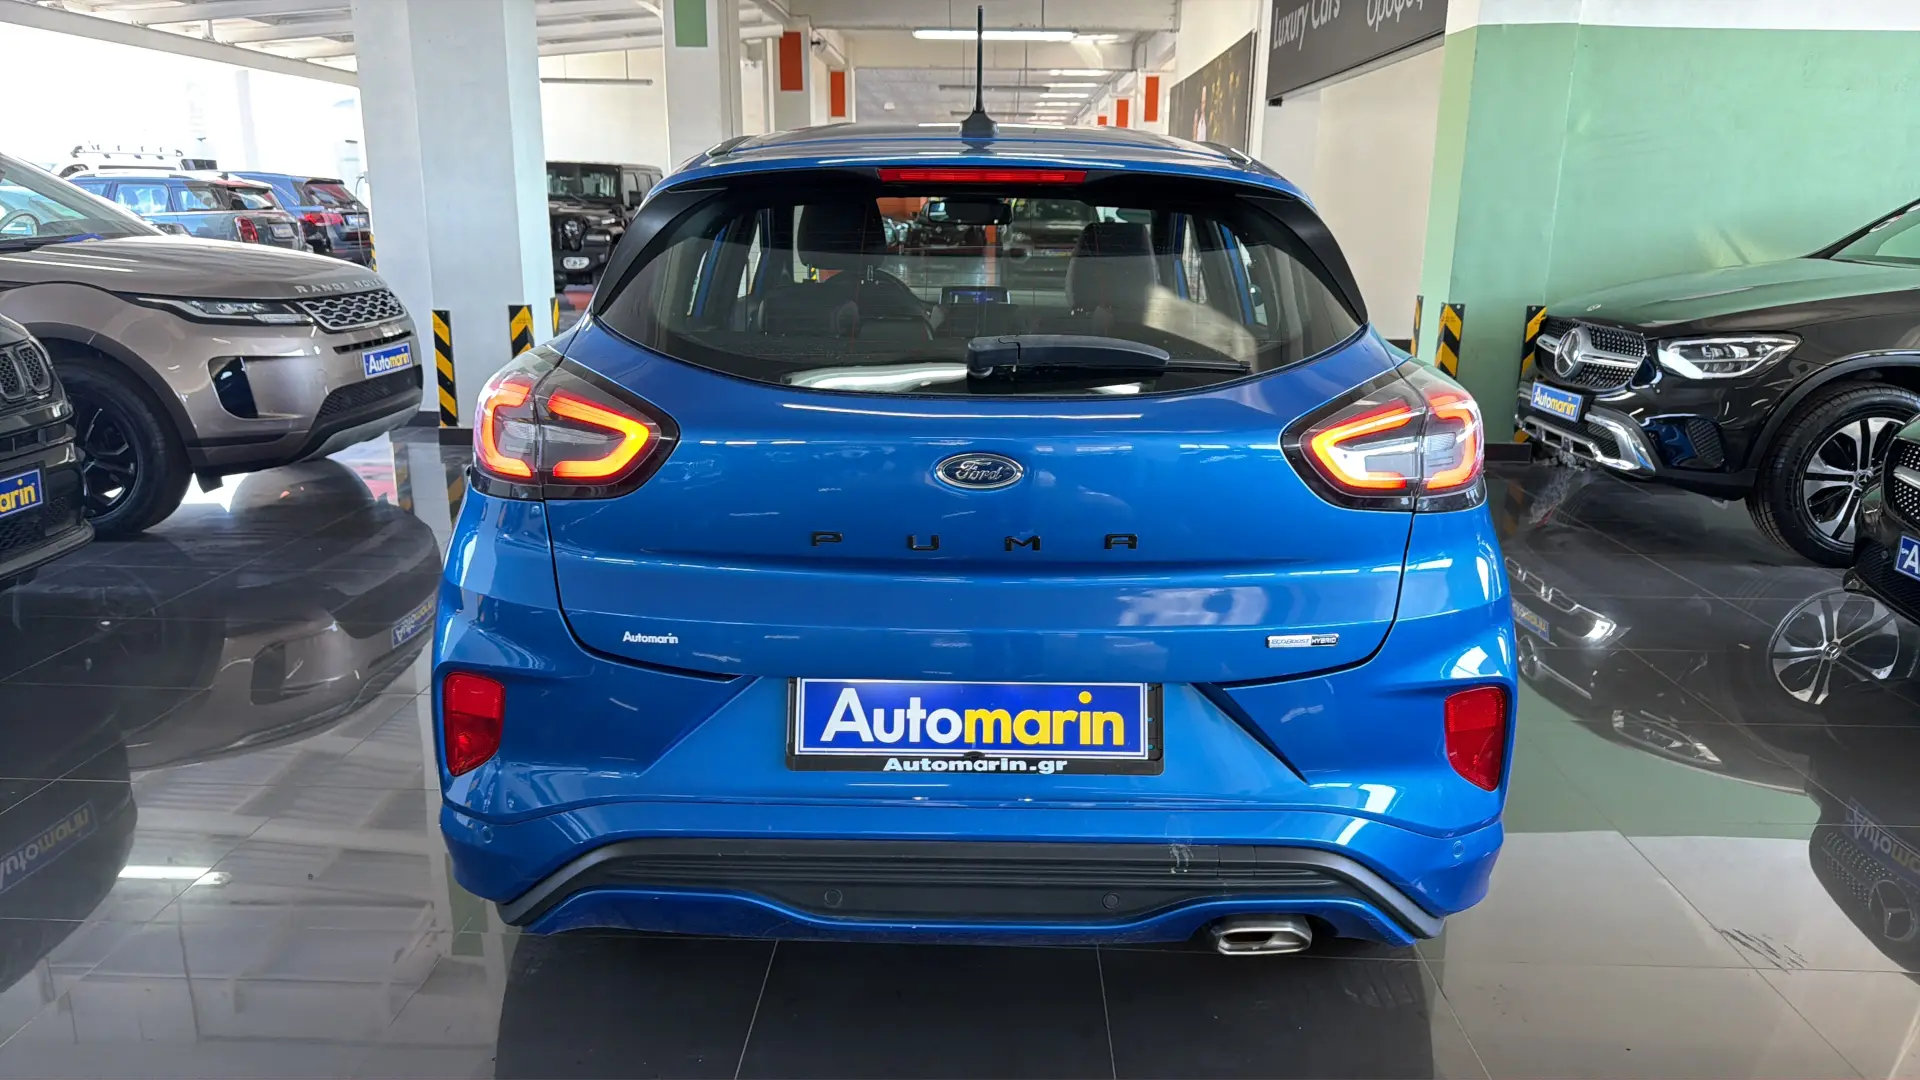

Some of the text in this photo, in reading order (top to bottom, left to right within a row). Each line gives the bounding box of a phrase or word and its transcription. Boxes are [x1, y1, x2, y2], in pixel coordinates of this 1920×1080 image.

[1273, 0, 1341, 51] Luxury Cars
[294, 282, 349, 294] RANGE
[368, 347, 411, 374] Automarin
[1533, 386, 1577, 417] Automarin
[955, 460, 1004, 480] Ford
[811, 531, 1138, 552] PUMA
[622, 631, 679, 644] Automarin
[820, 687, 1125, 746] Automarin
[883, 757, 1068, 775] Automarin.gr
